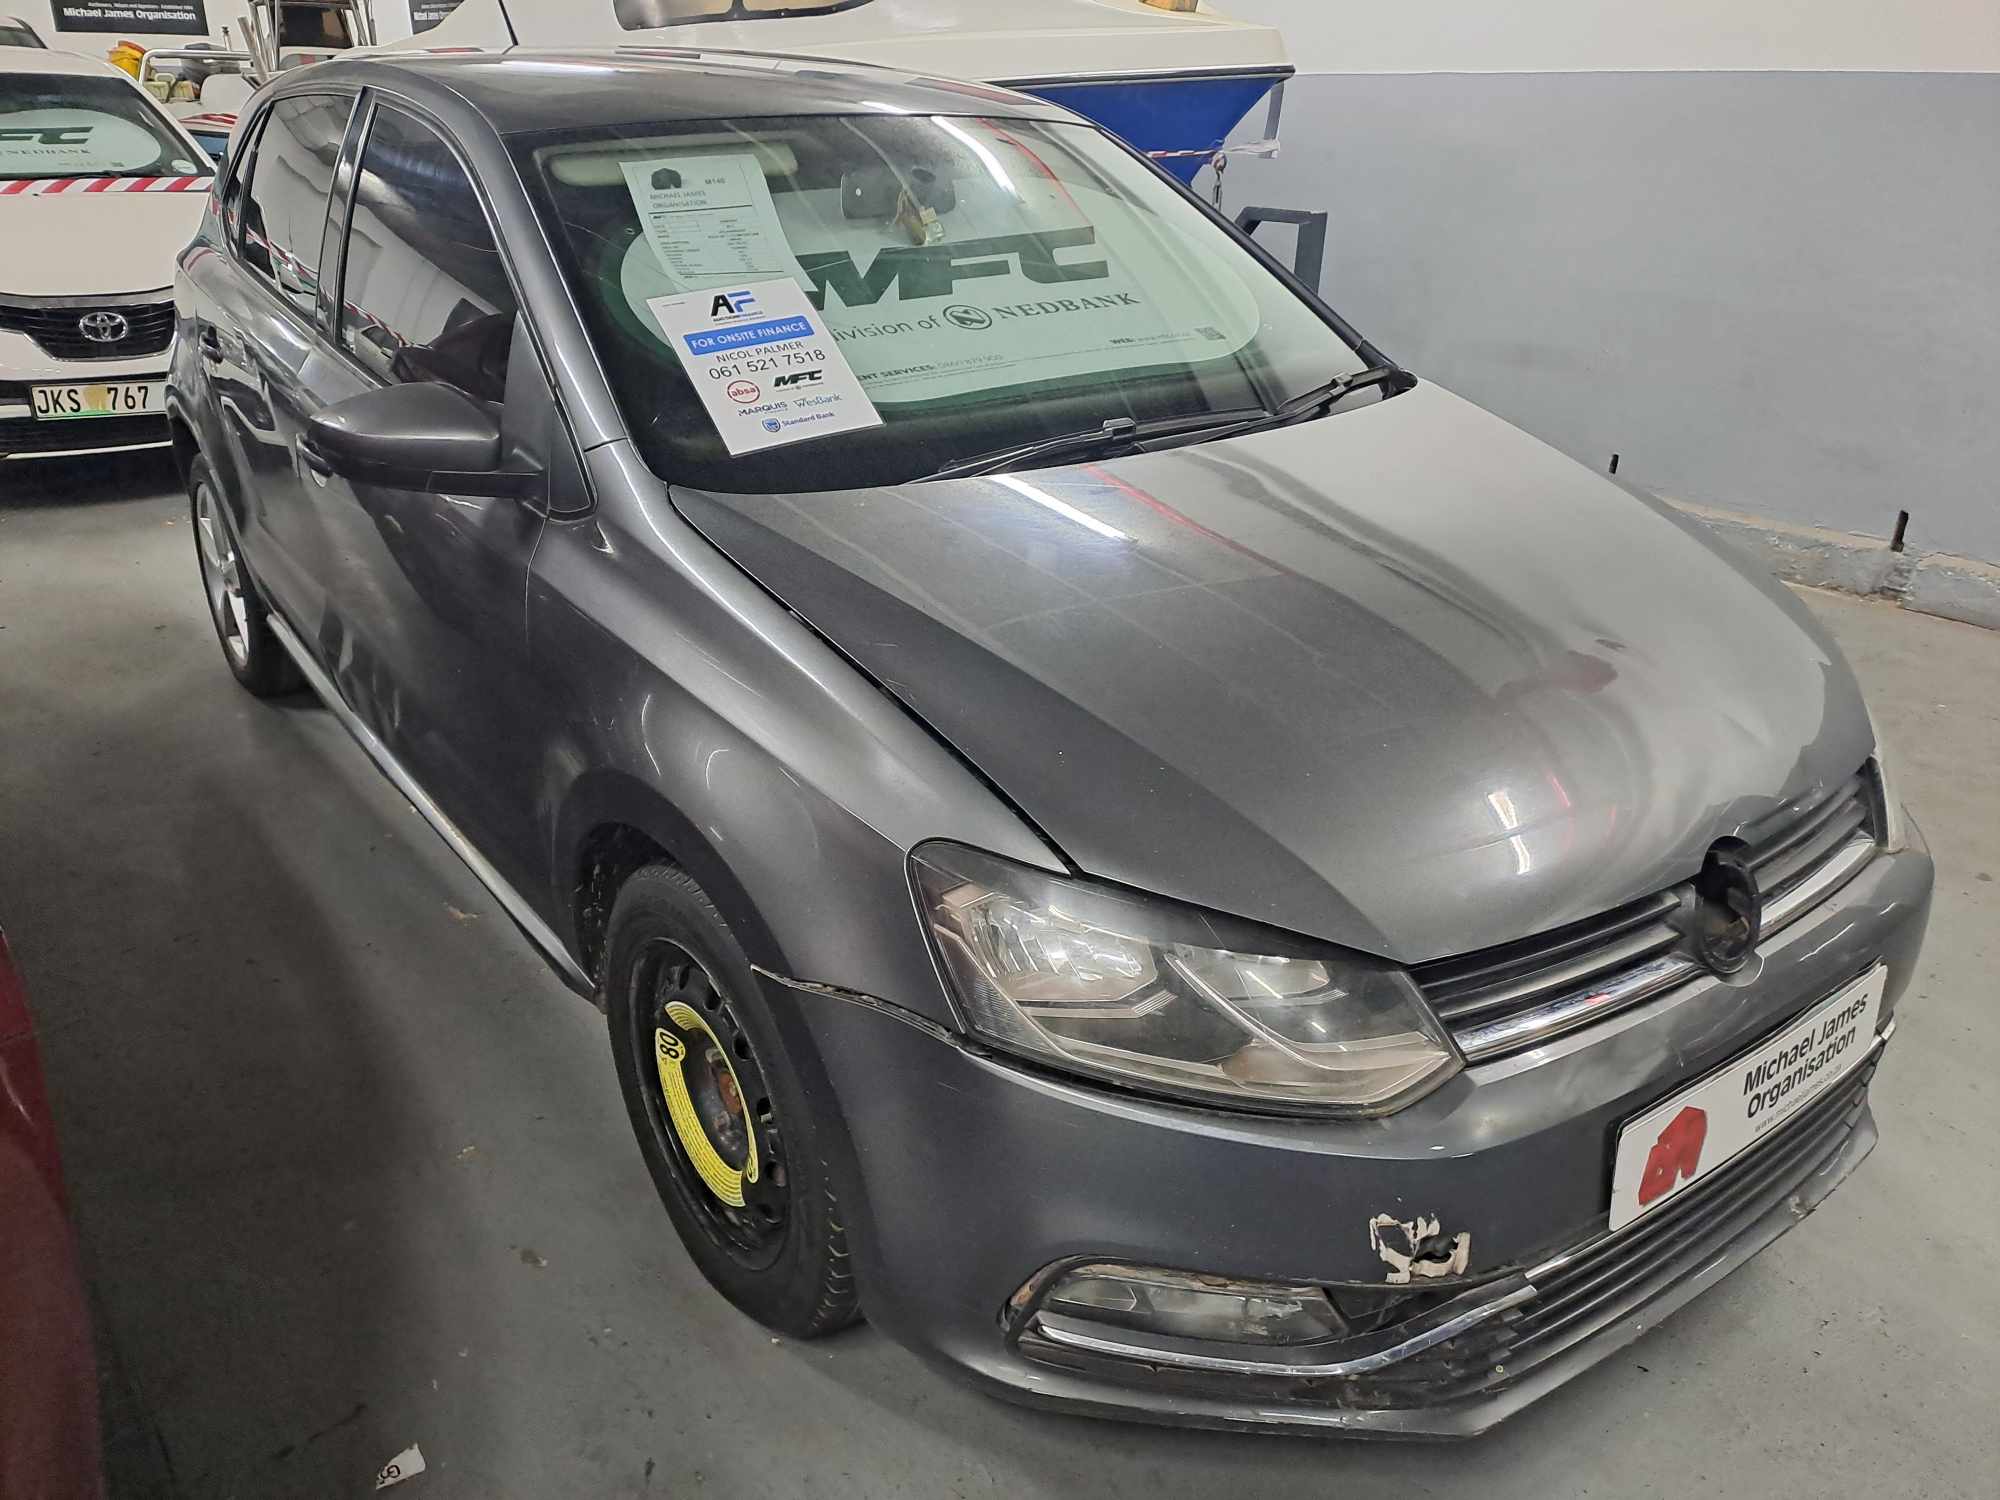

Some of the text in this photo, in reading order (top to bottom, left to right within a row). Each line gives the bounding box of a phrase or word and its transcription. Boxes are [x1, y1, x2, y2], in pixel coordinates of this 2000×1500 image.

[63, 8, 196, 20] Michael James Organisation
[711, 291, 756, 316] AF
[832, 293, 1141, 342] ivision of NEDBANK
[691, 321, 807, 349] FOR ONSITE FINANCE
[709, 349, 826, 380] 061 521 7518
[716, 341, 804, 363] NICOL PALMER
[774, 369, 823, 387] MFC
[37, 386, 148, 414] JKS 767
[731, 386, 757, 397] absa
[738, 401, 788, 416] MARQUIS
[781, 411, 835, 427] Standard Bank
[660, 1031, 680, 1059] 80
[1743, 992, 1869, 1095] Michael James
[1746, 1026, 1856, 1119] Organisation
